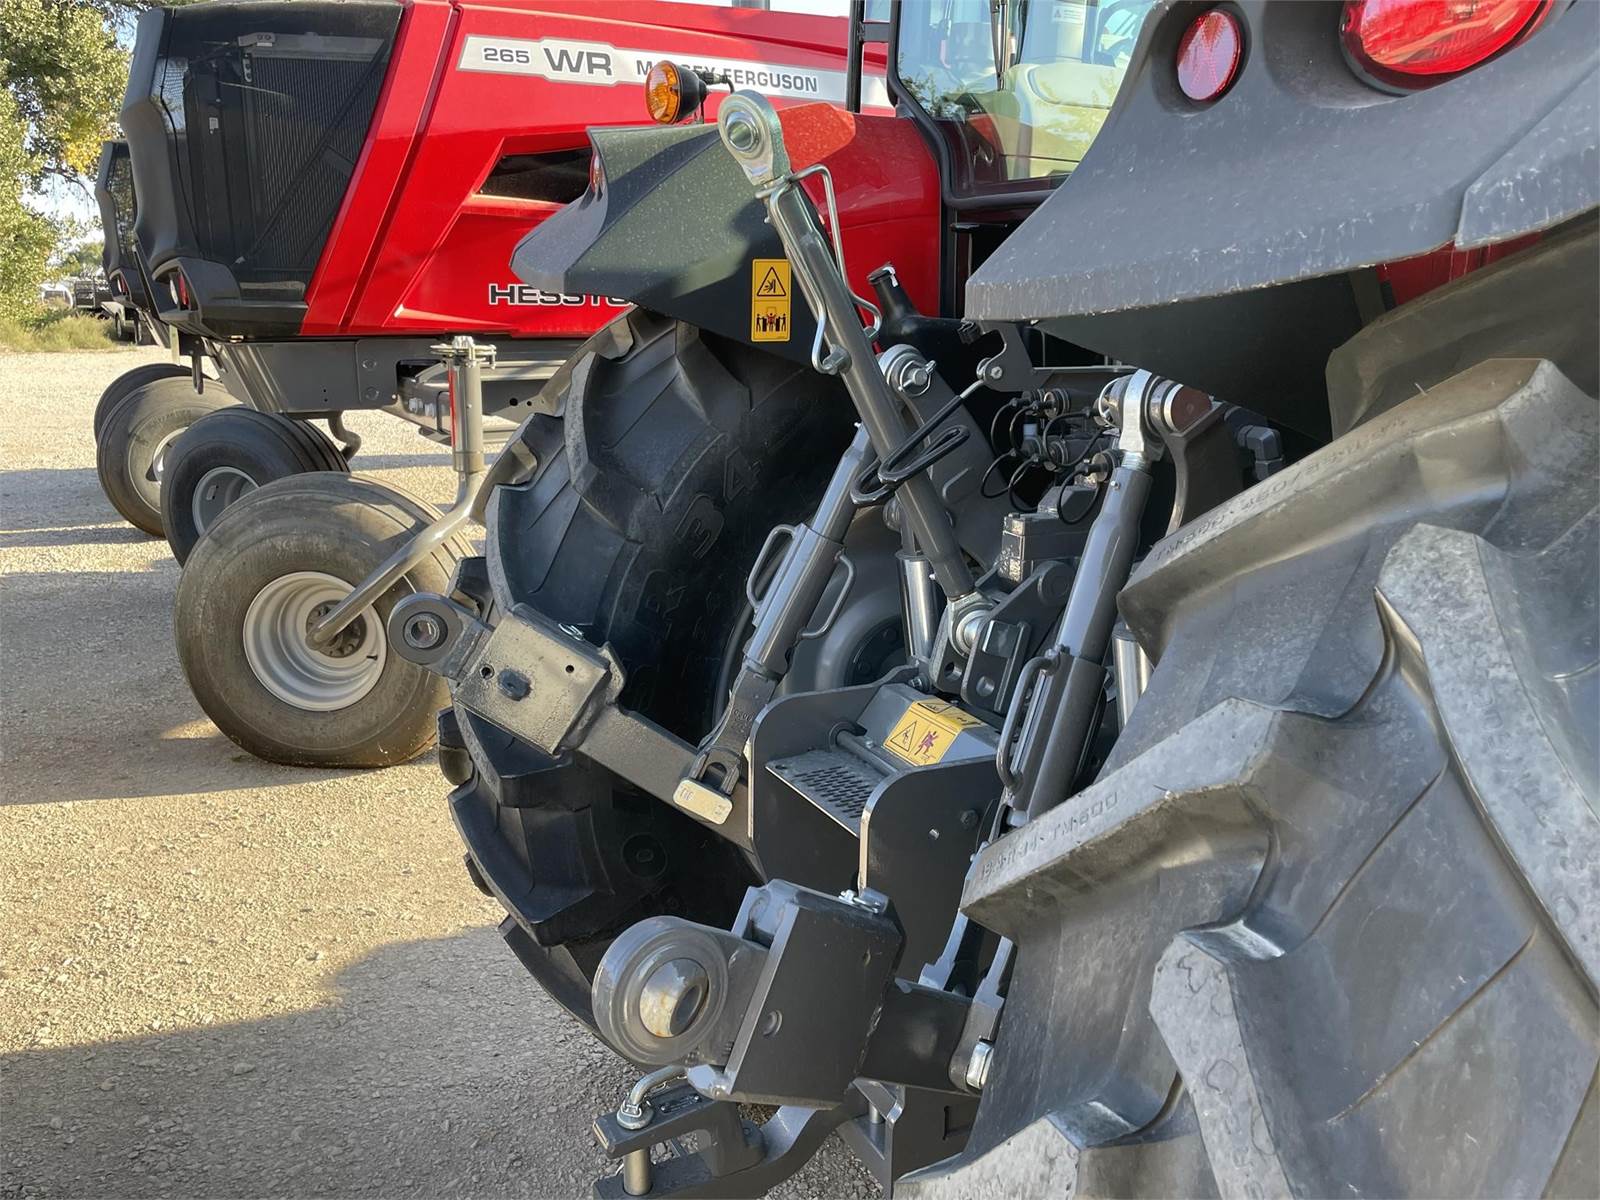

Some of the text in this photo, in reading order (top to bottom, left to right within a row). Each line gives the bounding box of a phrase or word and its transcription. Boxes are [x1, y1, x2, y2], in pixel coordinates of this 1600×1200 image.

[484, 47, 530, 64] 265
[543, 47, 613, 76] WR
[722, 68, 817, 93] FERGUSON
